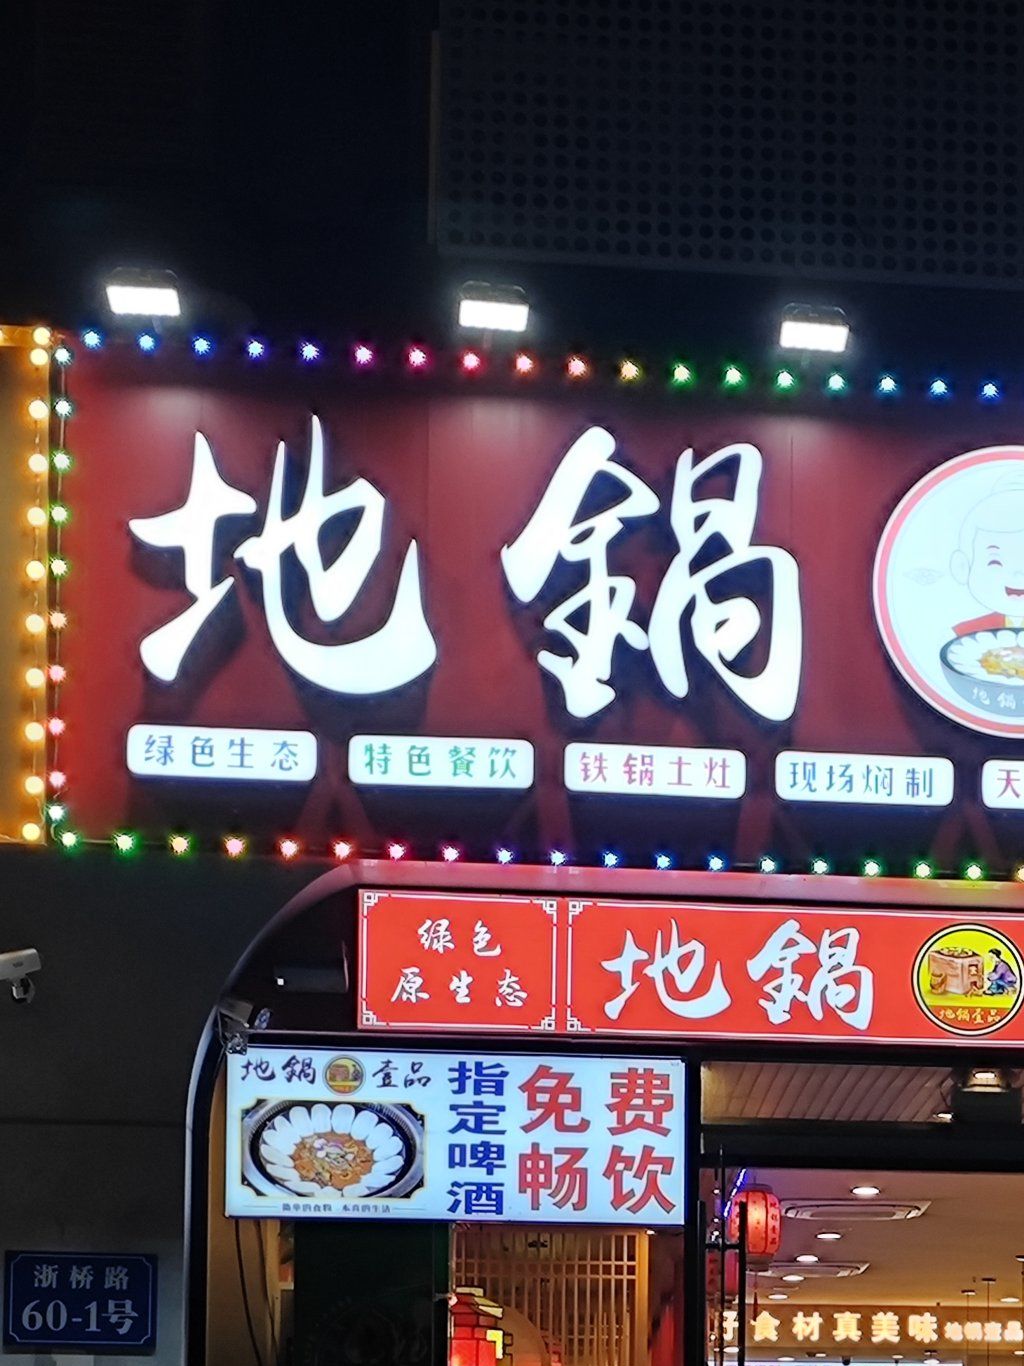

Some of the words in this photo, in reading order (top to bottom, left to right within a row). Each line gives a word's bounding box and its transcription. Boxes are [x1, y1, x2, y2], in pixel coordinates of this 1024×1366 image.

[144, 733, 301, 770] 绿色生态
[364, 742, 519, 781] 特色餐饮
[579, 752, 733, 791] 铁锅土灶
[790, 759, 935, 798] 现场焖制
[417, 918, 502, 957] 绿色
[390, 967, 529, 1008] 原生态
[372, 1058, 432, 1088] 壹品
[517, 1063, 675, 1137] 免费
[446, 1059, 510, 1216] 指定啤酒
[517, 1143, 677, 1215] 畅饮
[33, 1263, 130, 1290] 浙桥路
[20, 1298, 139, 1335] 60-1号
